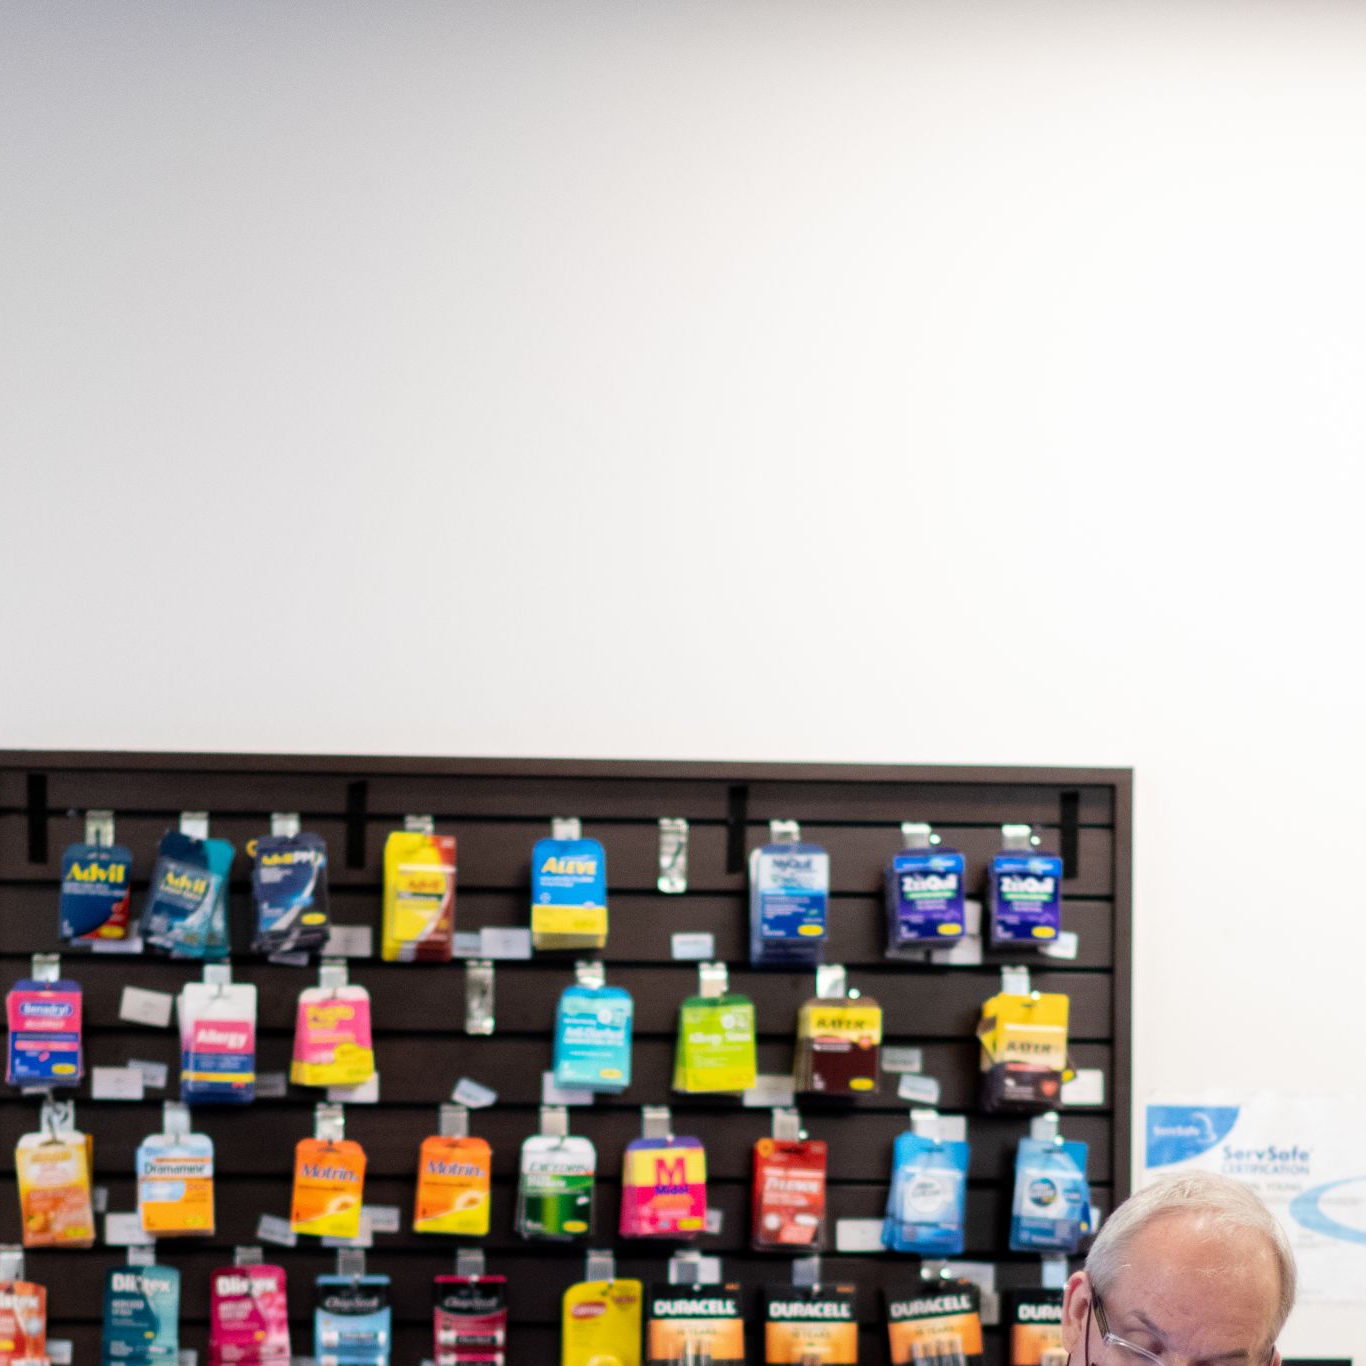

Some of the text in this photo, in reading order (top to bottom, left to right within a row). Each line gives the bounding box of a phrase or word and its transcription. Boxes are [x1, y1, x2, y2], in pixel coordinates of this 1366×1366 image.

[66, 862, 126, 884] Advil
[541, 857, 598, 875] ALEVE
[197, 1029, 247, 1049] Allergy
[1222, 1146, 1310, 1162] ServSafe
[145, 1162, 206, 1175] Dramamine
[300, 1162, 356, 1182] Motrin
[426, 1159, 482, 1177] Motrin
[655, 1184, 689, 1194] Midol
[653, 1299, 737, 1316] DURACELL
[768, 1302, 851, 1318] DURACELL
[890, 1295, 971, 1318] DURACELL
